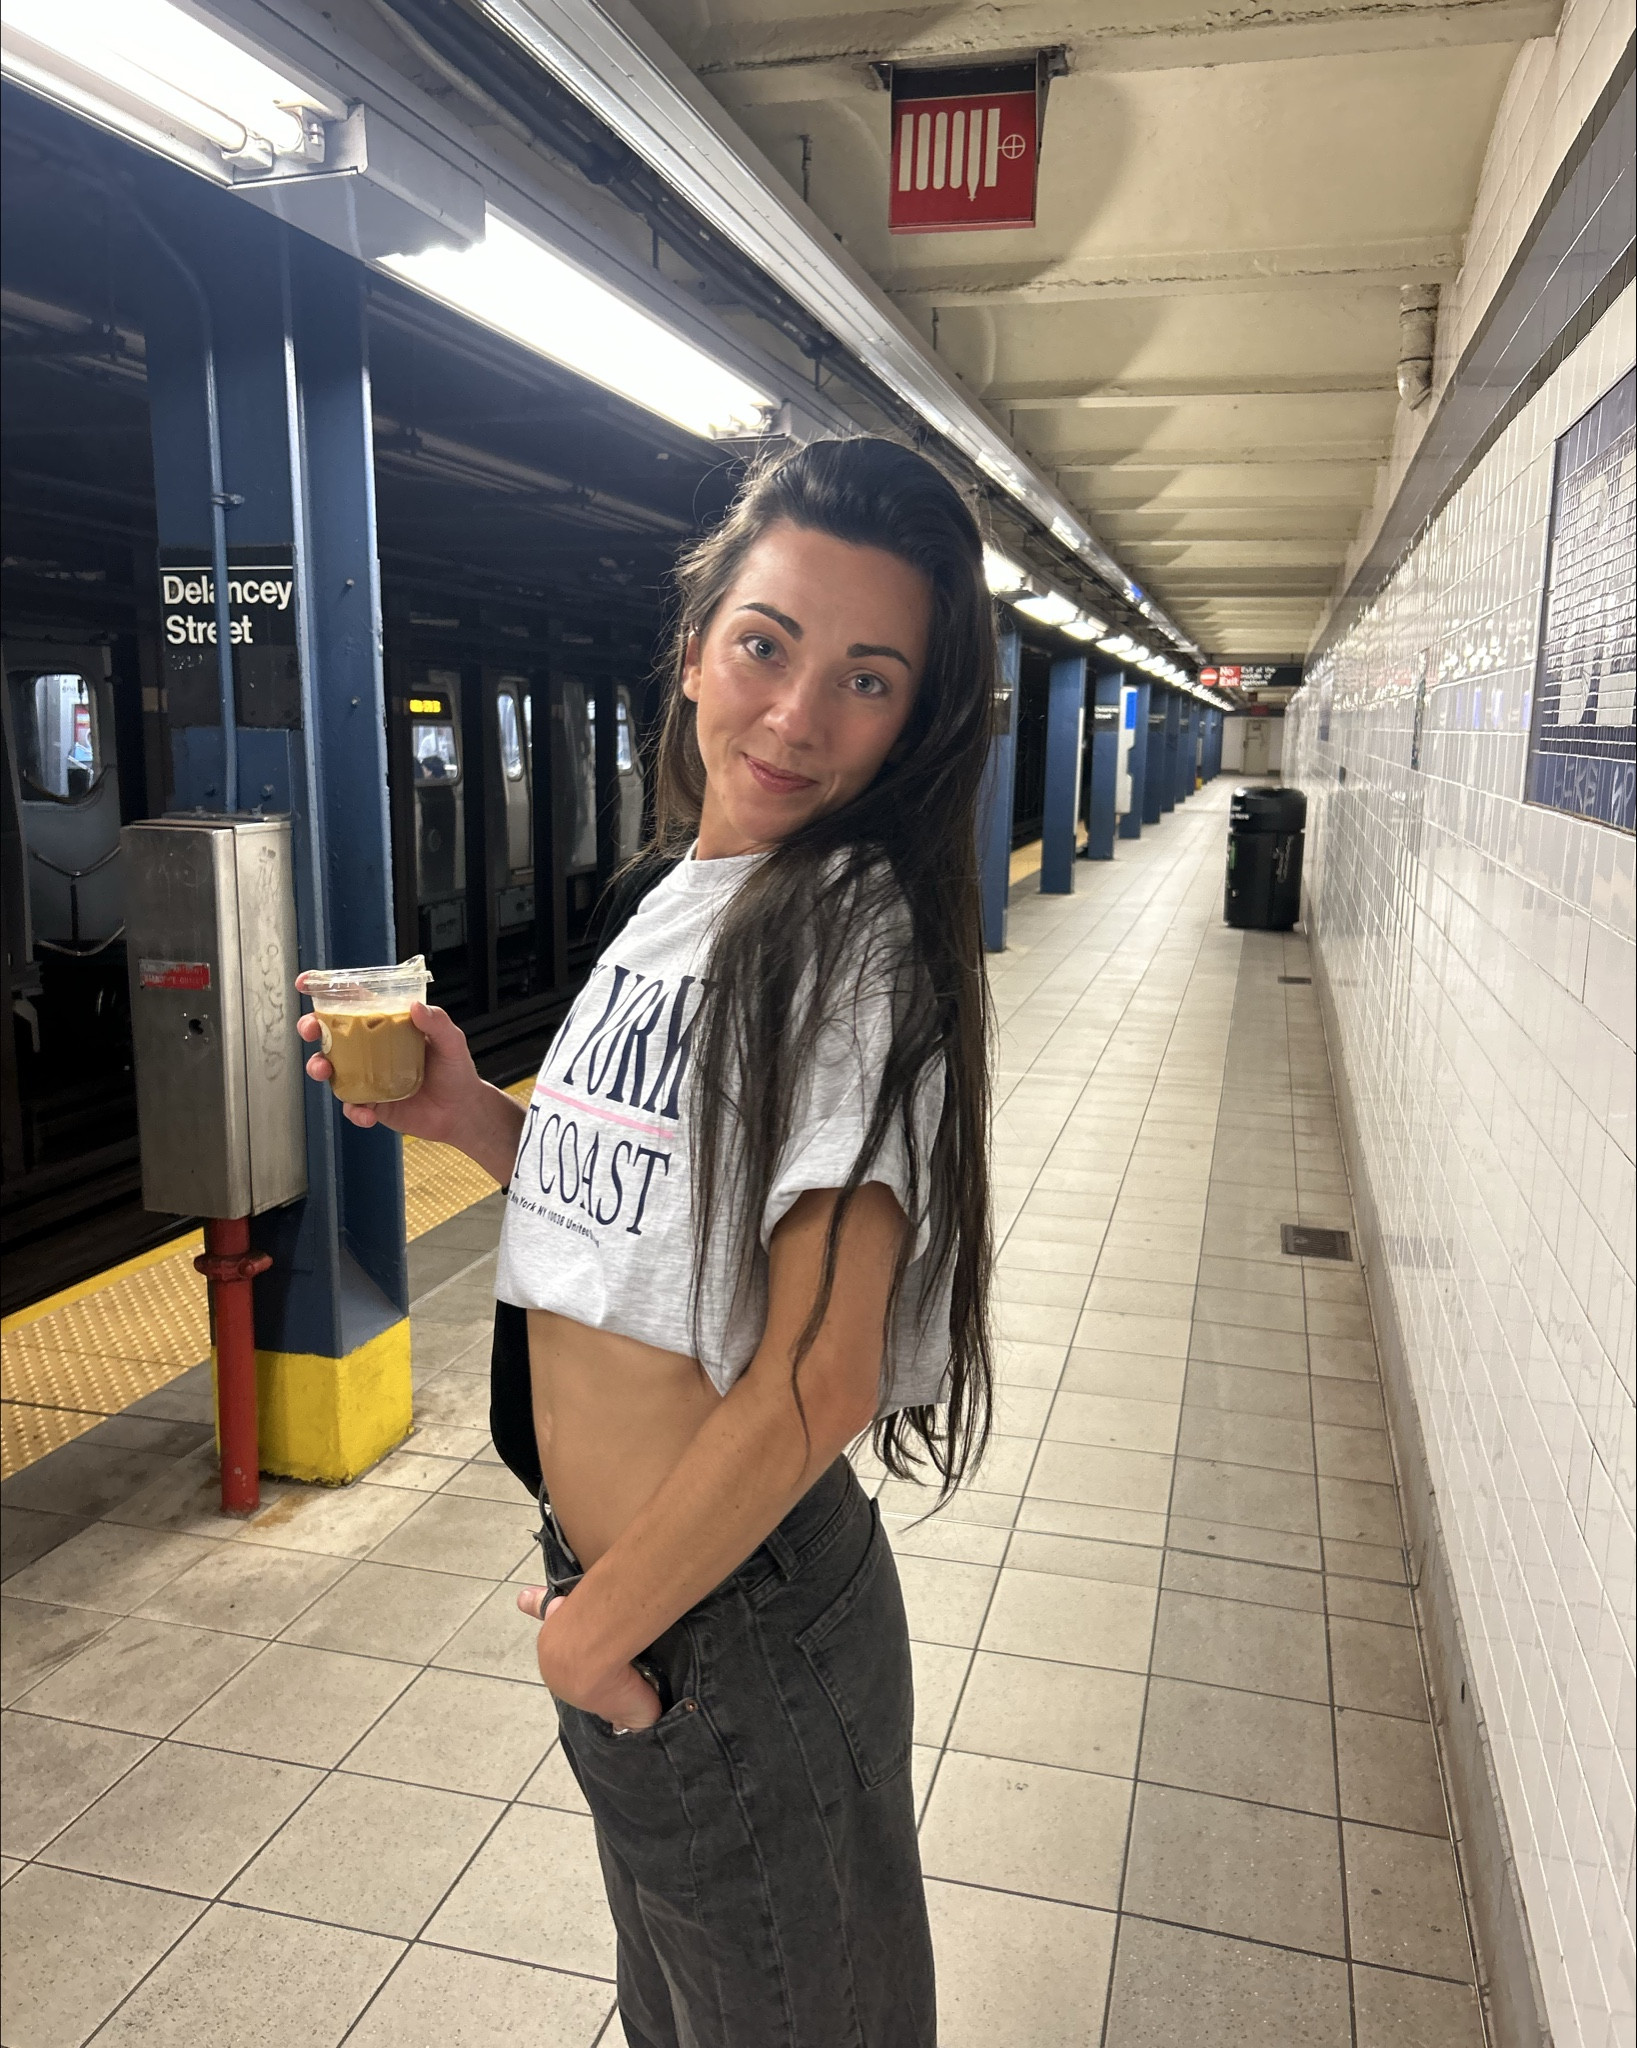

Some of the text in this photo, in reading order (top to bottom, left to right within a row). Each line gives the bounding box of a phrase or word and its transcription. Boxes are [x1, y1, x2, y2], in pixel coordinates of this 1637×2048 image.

[166, 614, 254, 645] Street
[1219, 677, 1239, 687] Exit
[1220, 666, 1235, 677] No
[540, 1113, 672, 1236] COAST
[519, 1196, 536, 1212] York
[537, 1205, 547, 1218] NY
